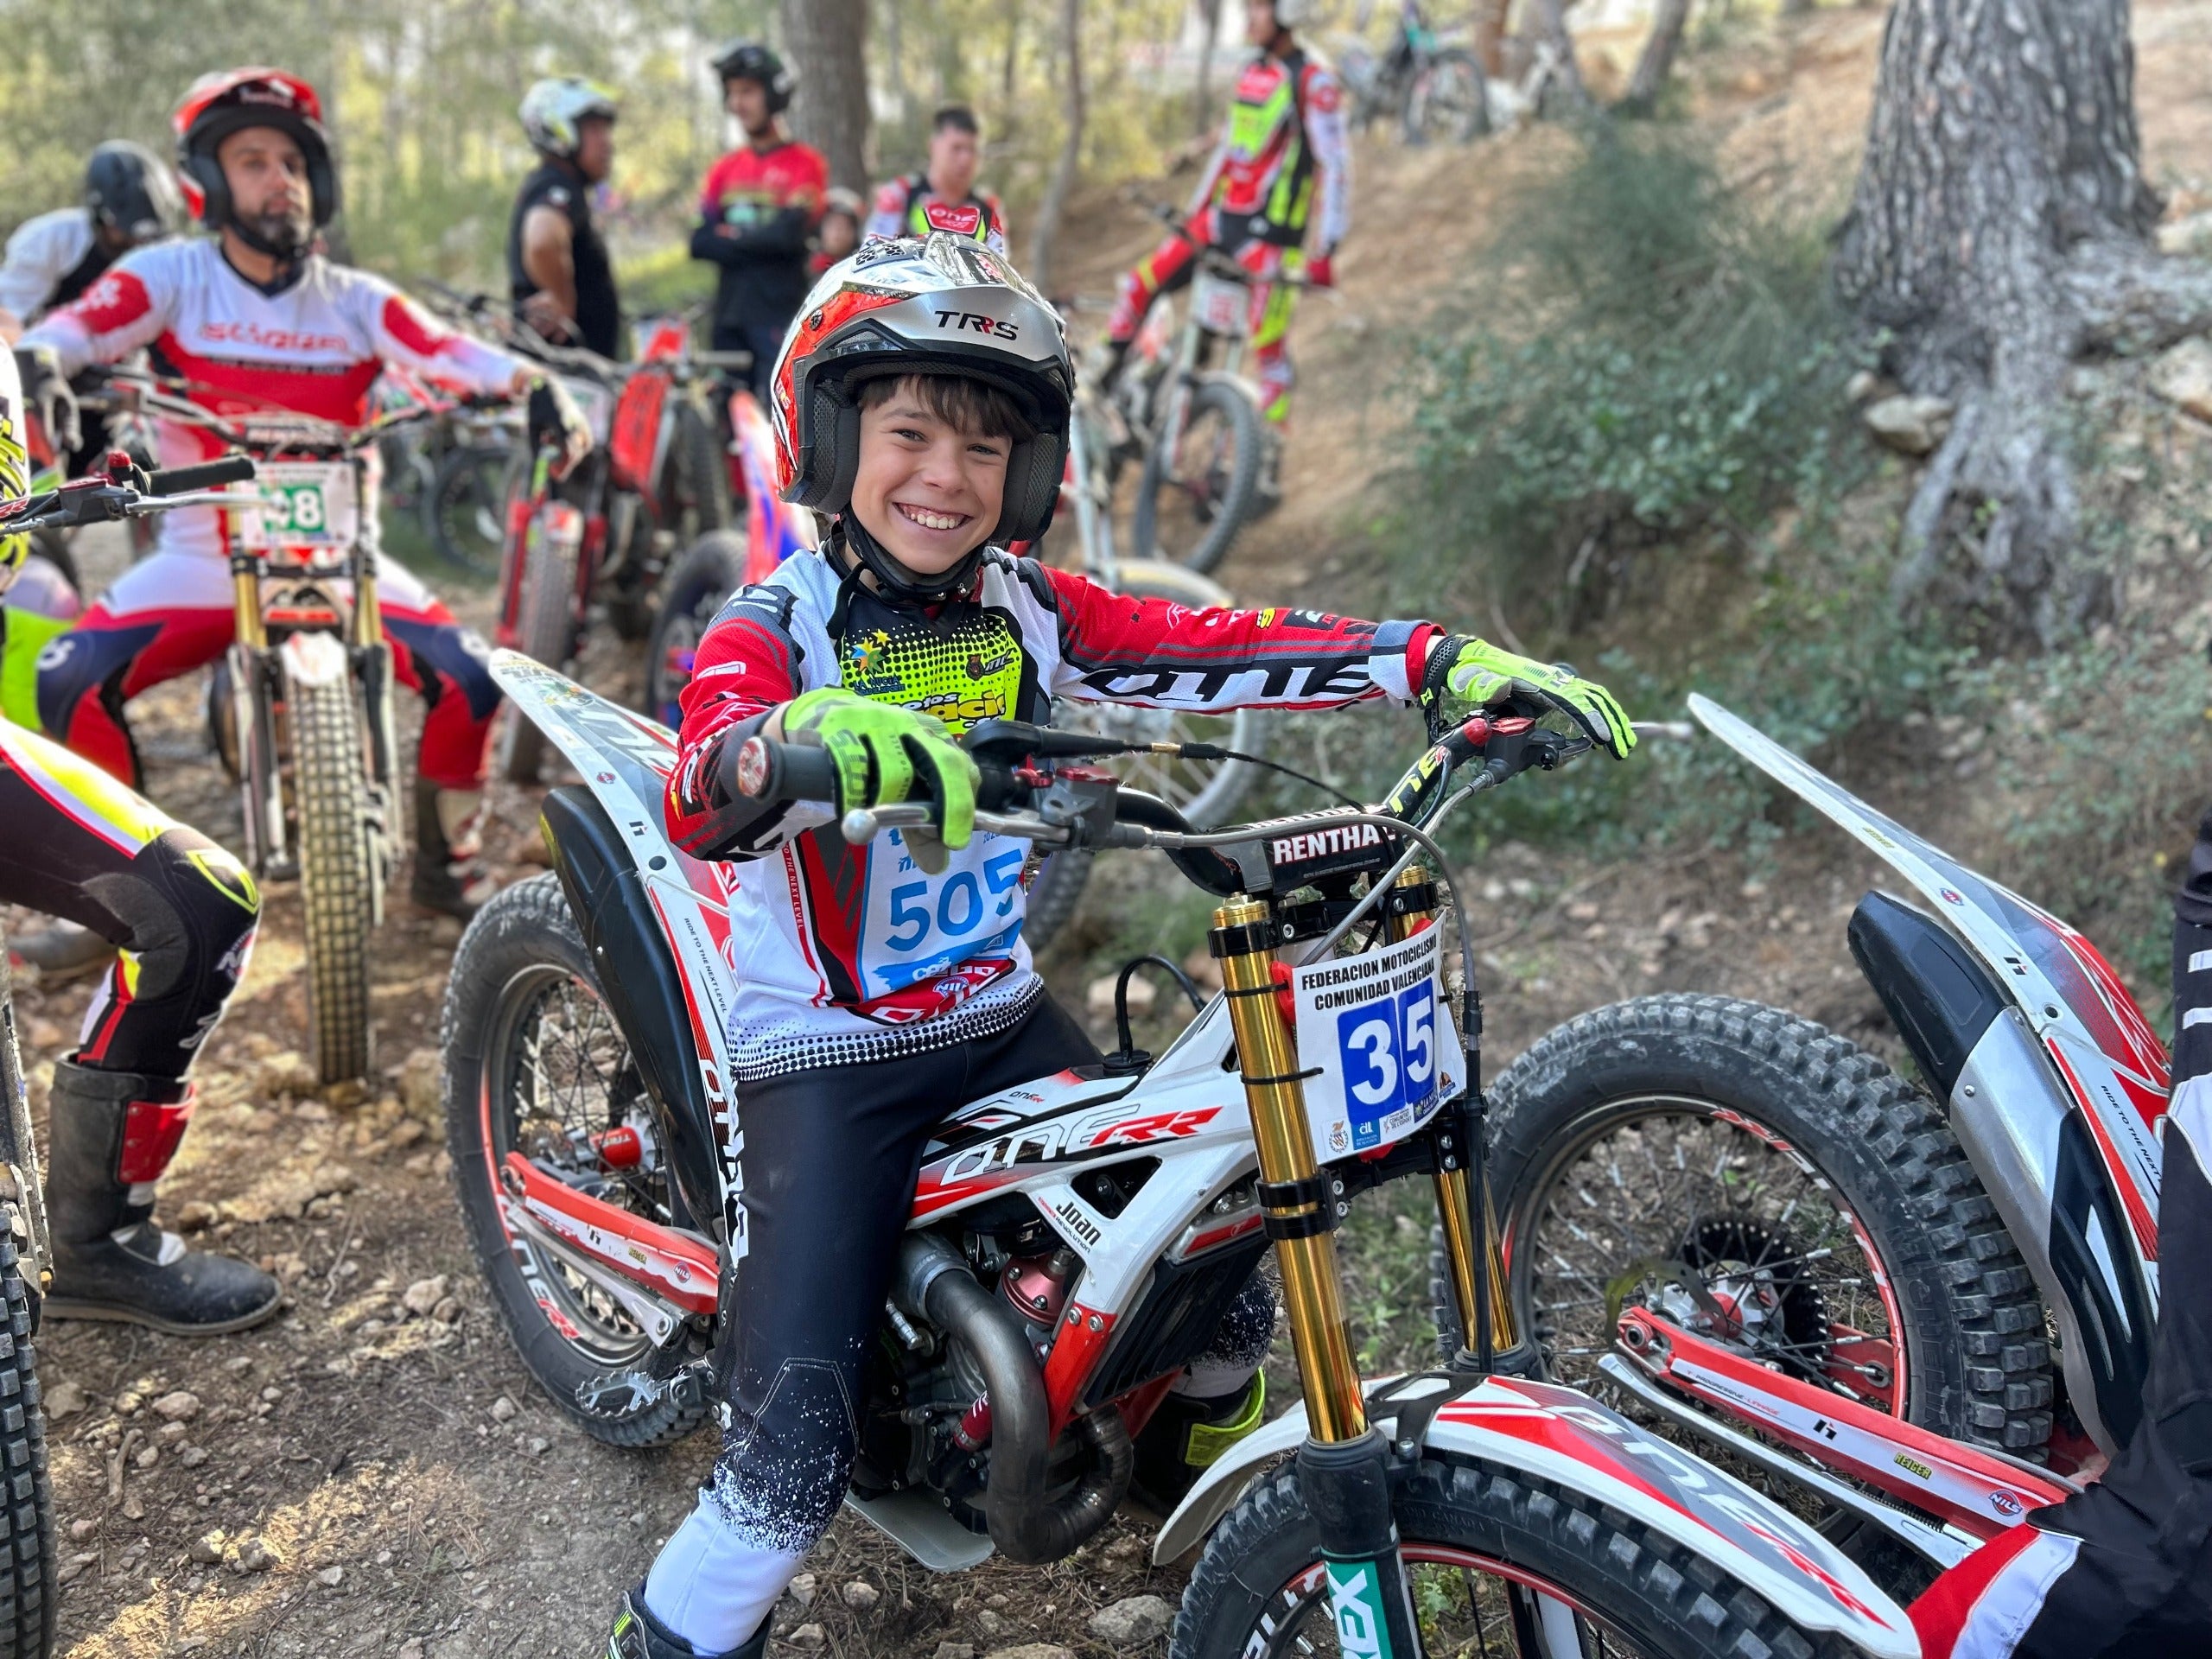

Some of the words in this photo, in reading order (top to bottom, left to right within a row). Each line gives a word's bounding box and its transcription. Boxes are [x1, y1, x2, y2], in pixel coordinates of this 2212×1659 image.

[784, 857, 794, 874] THE
[789, 875, 799, 900] NEXT
[793, 900, 804, 929] LEVEL
[885, 849, 1023, 952] 505
[684, 918, 696, 936] RIDE
[692, 937, 702, 950] TO
[698, 949, 709, 965] THE
[705, 965, 719, 988] NEXT
[713, 987, 728, 1014] LEVEL
[1301, 959, 1379, 990] FEDERACION
[1381, 932, 1437, 972] MOTOCICLISMO
[1314, 977, 1390, 1011] COMUNIDAD
[1391, 957, 1435, 992] VALENCIANA
[1347, 995, 1433, 1105] 35
[2101, 1085, 2120, 1109] RIDE
[2118, 1109, 2130, 1124] TO
[2128, 1127, 2144, 1147] THE
[2141, 1148, 2162, 1177] NEXT
[1988, 1493, 2023, 1515] NILS
